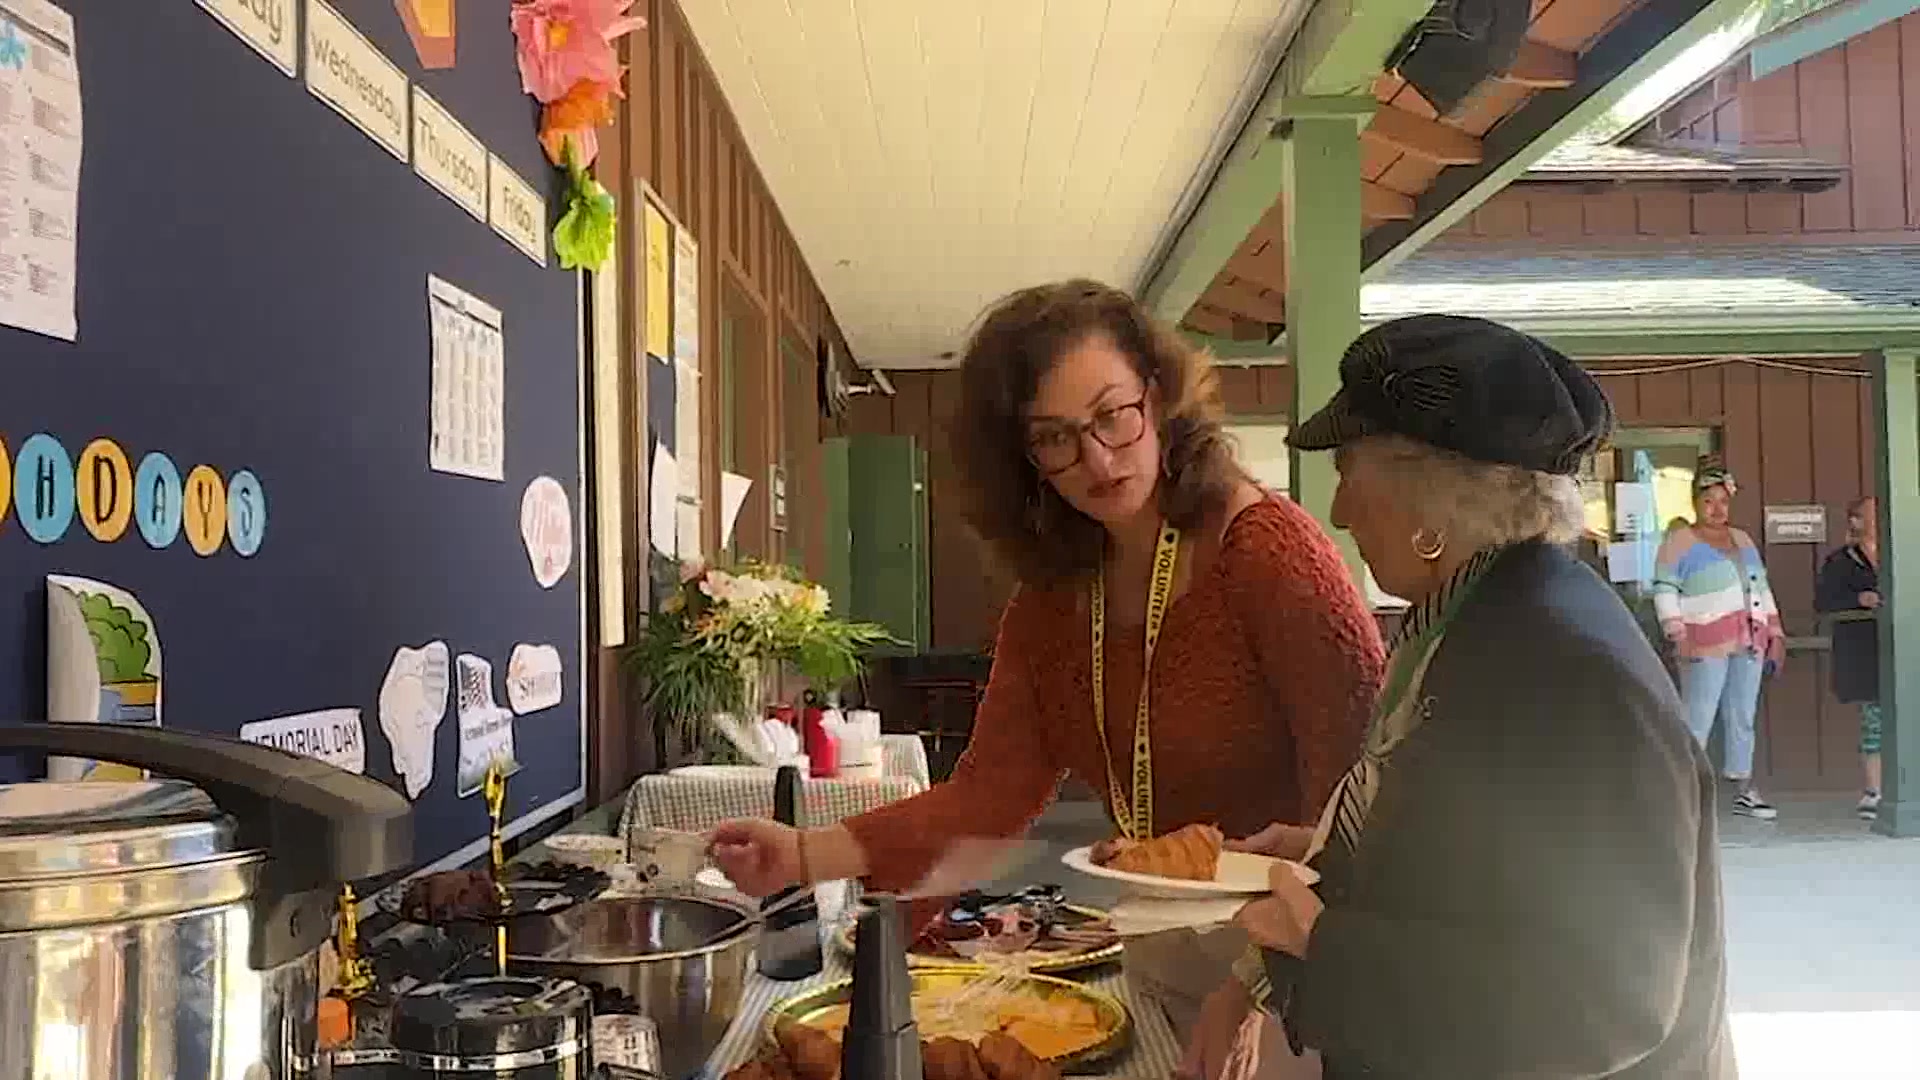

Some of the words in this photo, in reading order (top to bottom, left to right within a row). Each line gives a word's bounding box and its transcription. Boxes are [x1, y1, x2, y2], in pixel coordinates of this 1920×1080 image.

[310, 31, 402, 136] Wednesday
[418, 116, 483, 205] Thursday
[1150, 547, 1176, 631] VOLUNTEER
[333, 718, 359, 753] DAY
